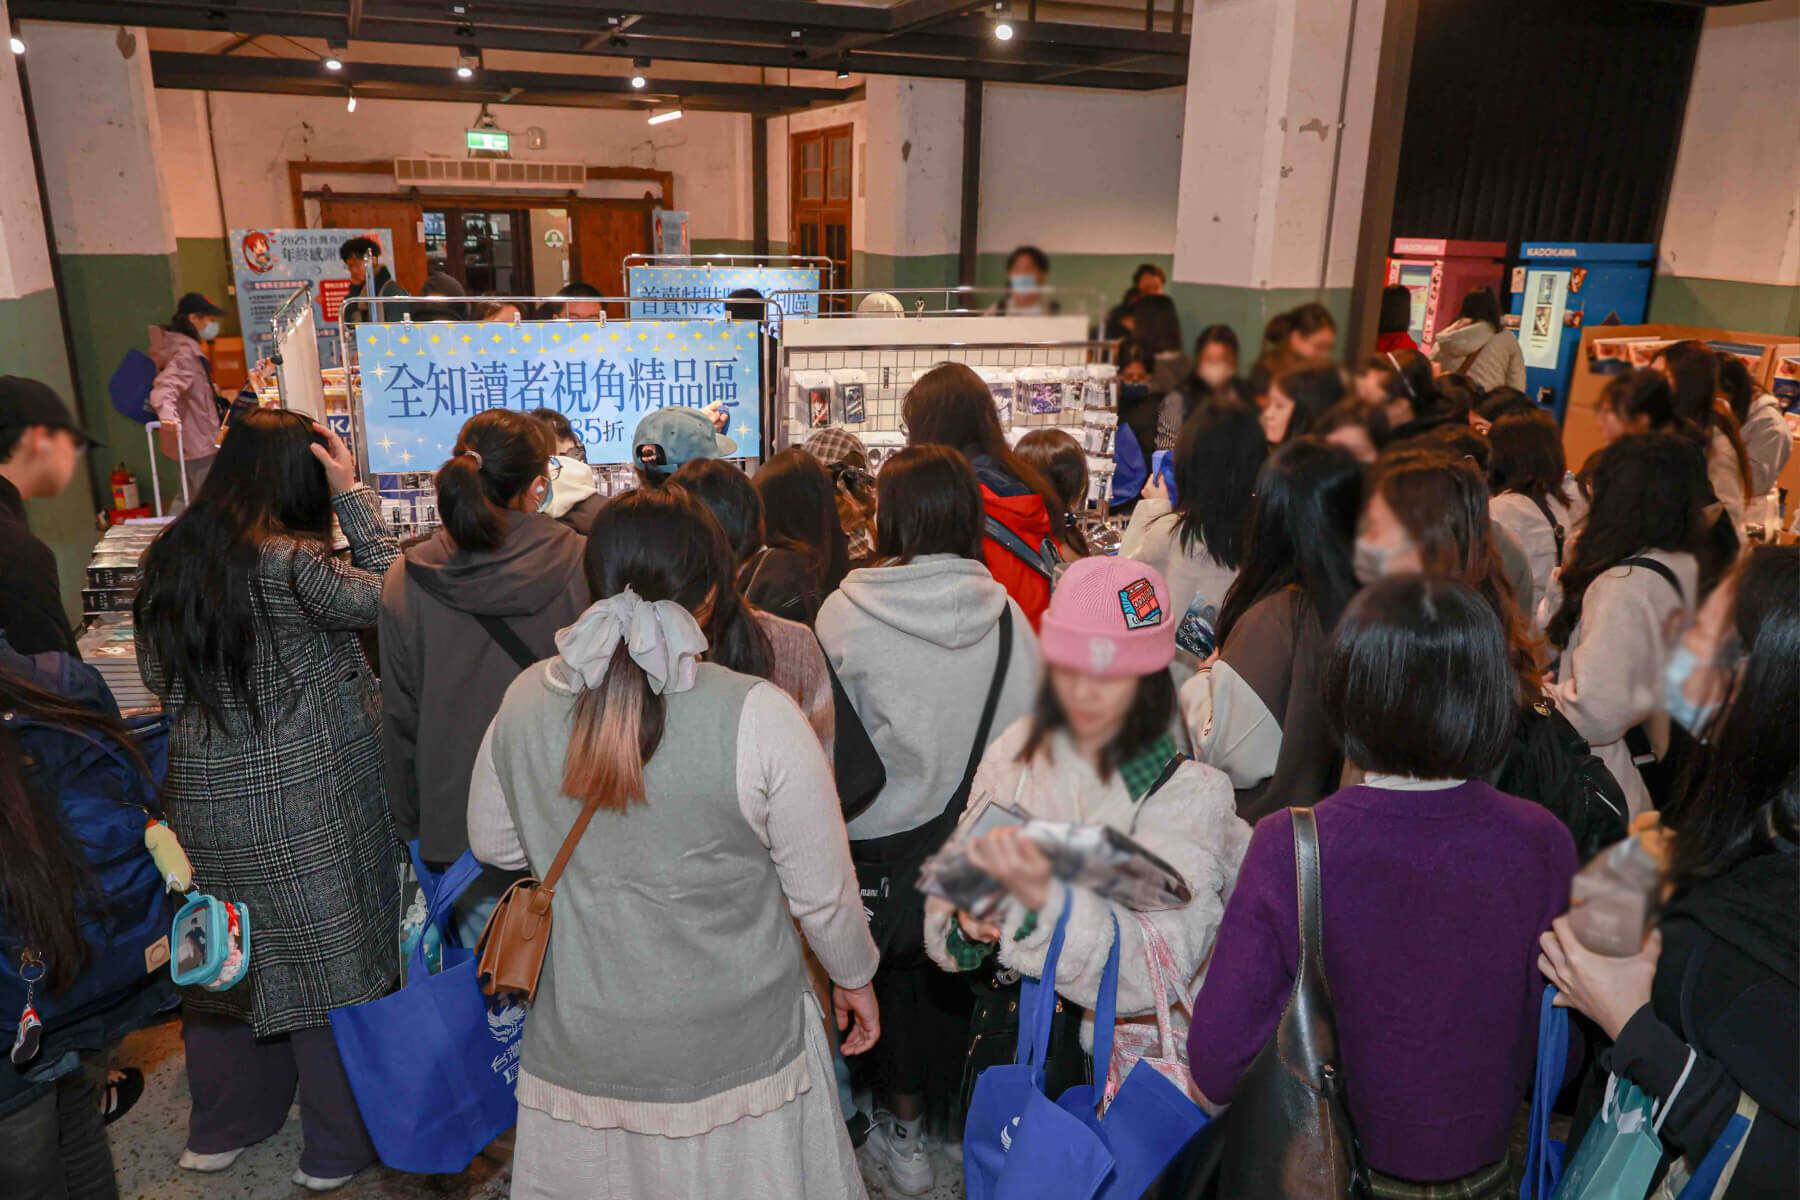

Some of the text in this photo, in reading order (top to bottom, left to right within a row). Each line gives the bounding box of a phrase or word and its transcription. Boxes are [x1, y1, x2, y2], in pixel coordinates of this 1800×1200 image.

[1527, 248, 1577, 257] KADOKAWA
[384, 356, 740, 418] 全知讀者視角精品區
